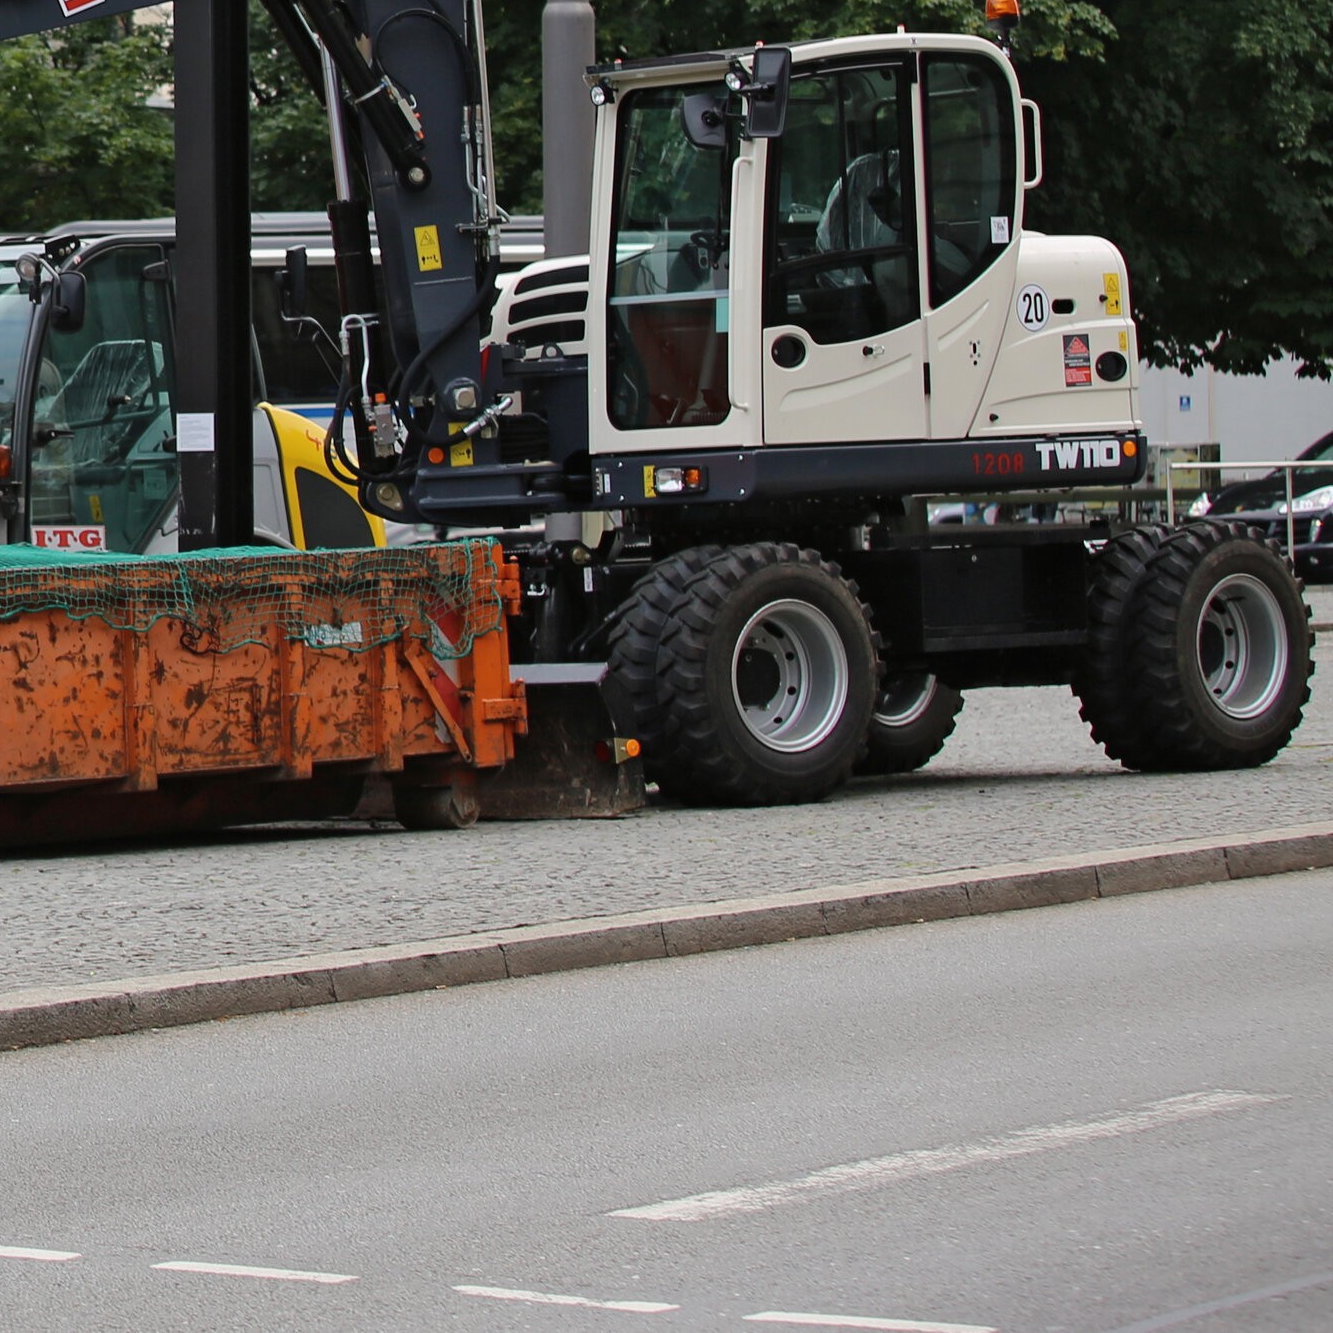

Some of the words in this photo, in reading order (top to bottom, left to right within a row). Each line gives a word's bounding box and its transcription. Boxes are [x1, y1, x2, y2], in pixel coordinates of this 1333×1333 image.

[1022, 292, 1044, 324] 20
[972, 453, 1025, 475] 1208
[1035, 440, 1121, 470] TW110
